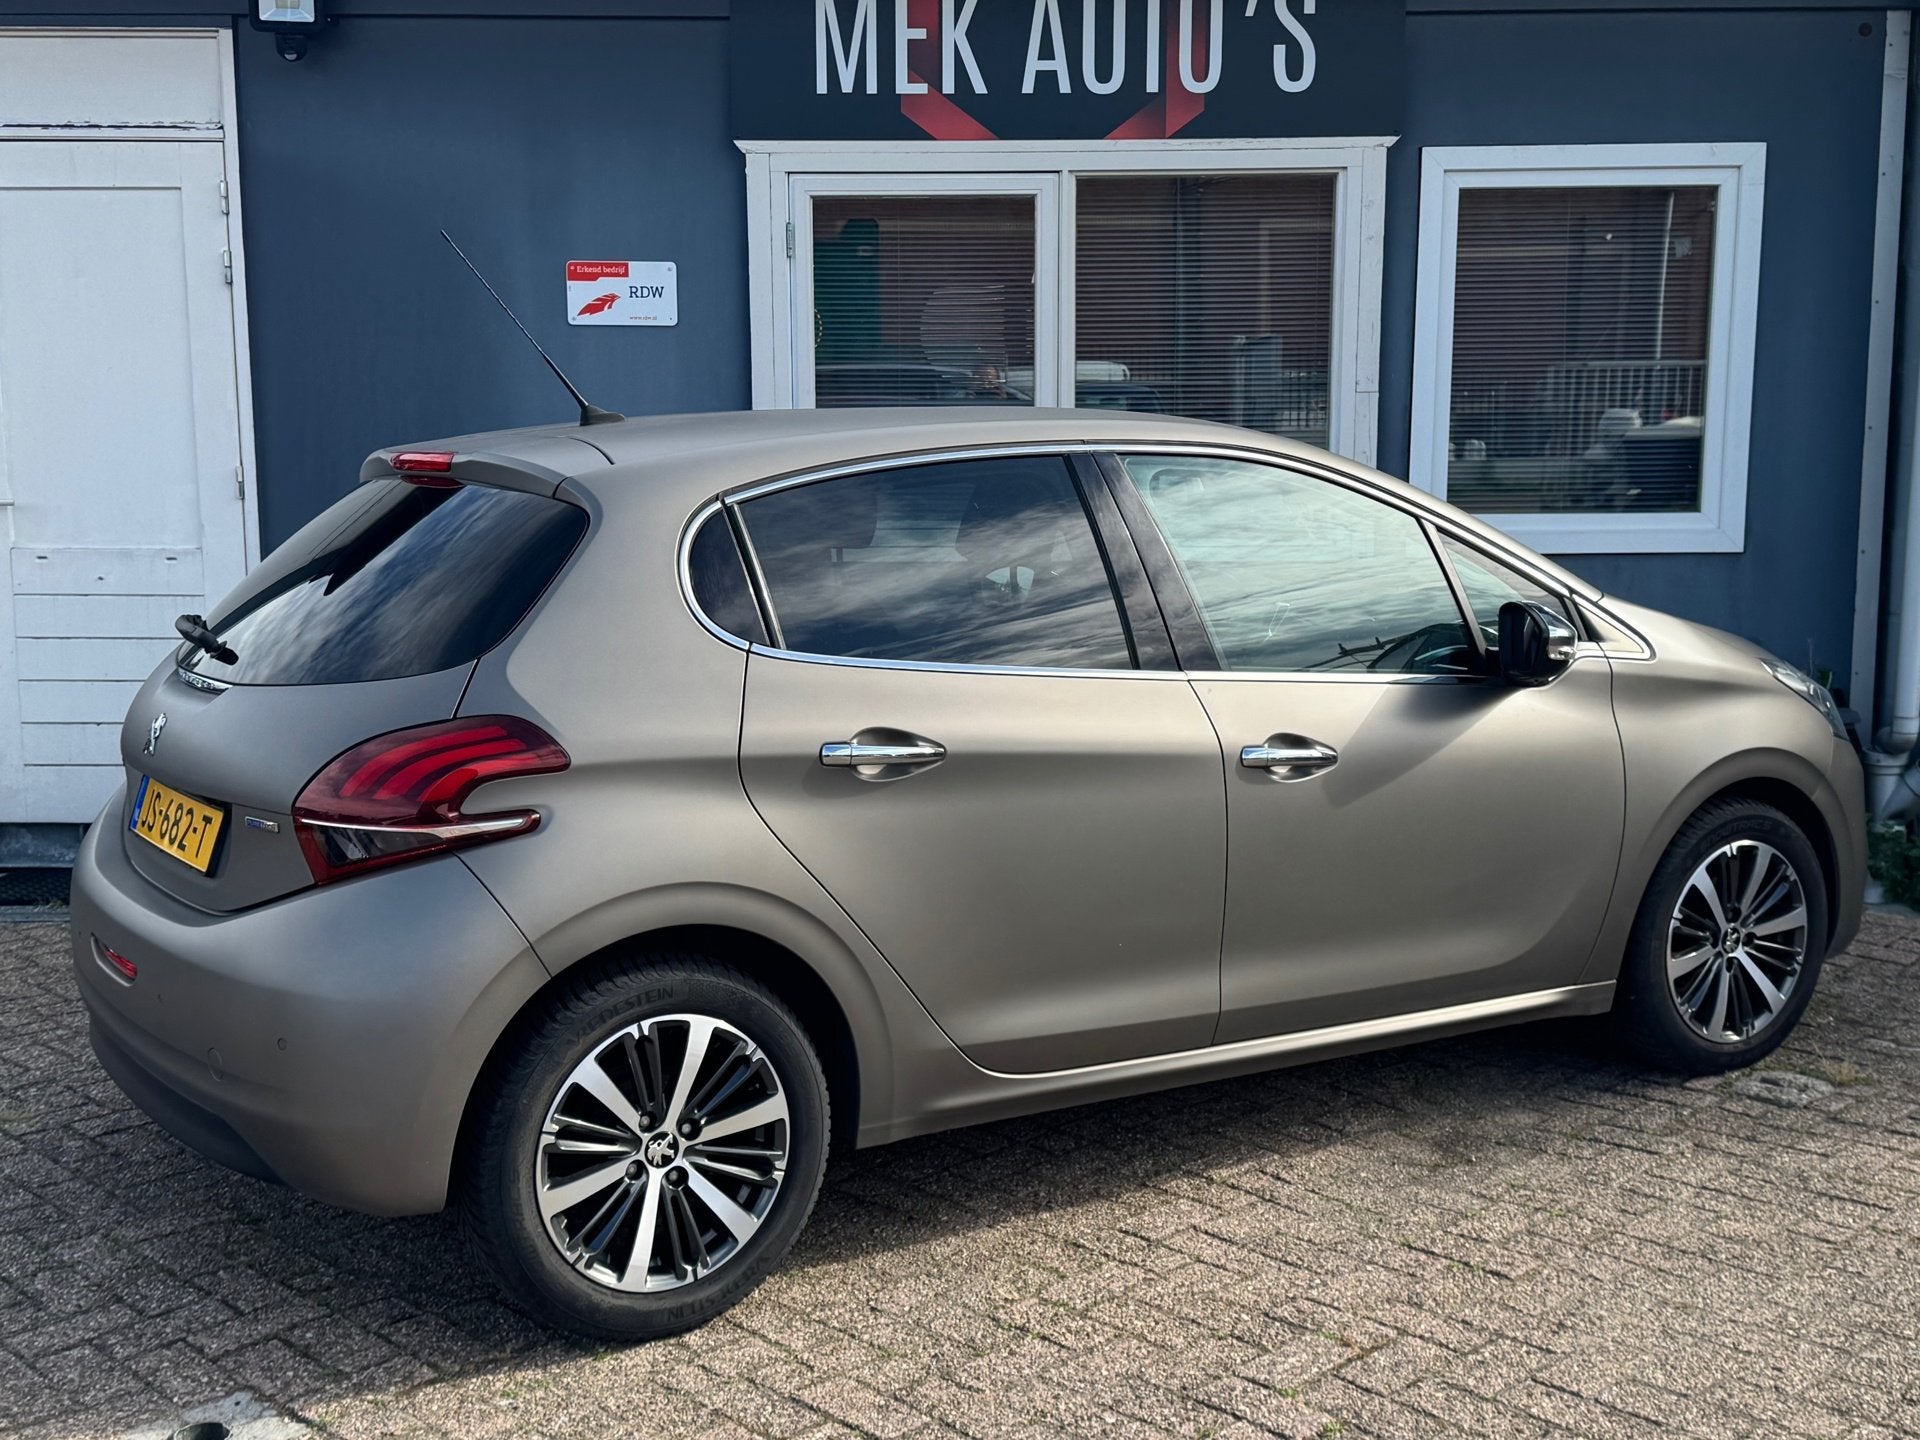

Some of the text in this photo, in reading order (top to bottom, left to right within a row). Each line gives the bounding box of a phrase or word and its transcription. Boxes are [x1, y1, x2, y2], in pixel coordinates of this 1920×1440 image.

[815, 0, 988, 95] MEK
[576, 265, 626, 275] Erkend bedrijf
[628, 285, 665, 299] RDW
[141, 788, 213, 859] JS-682-T
